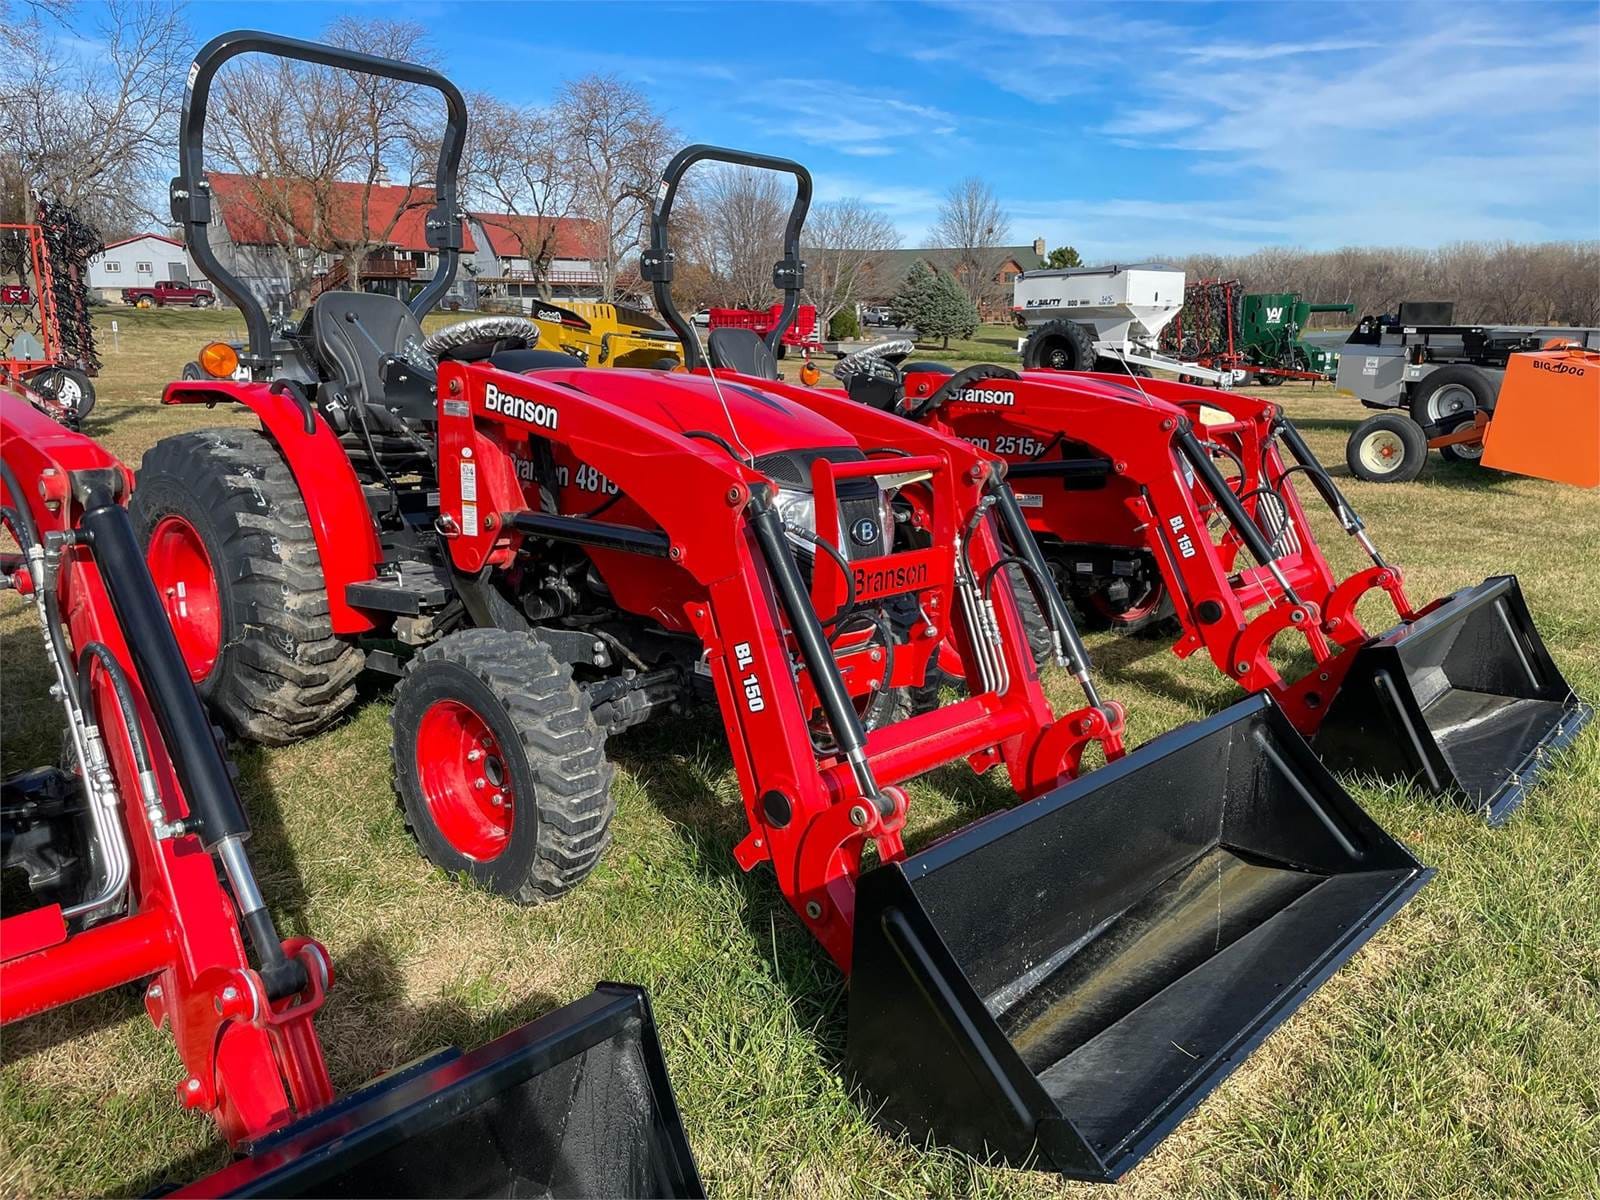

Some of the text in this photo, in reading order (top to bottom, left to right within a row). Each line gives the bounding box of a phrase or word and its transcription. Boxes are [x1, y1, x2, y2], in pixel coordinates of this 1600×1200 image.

[1533, 360, 1585, 377] BIG DOG
[485, 383, 559, 430] Branson
[861, 522, 874, 541] B
[1169, 515, 1196, 558] BL 150
[853, 563, 927, 596] Branson
[734, 642, 765, 713] BL 150
